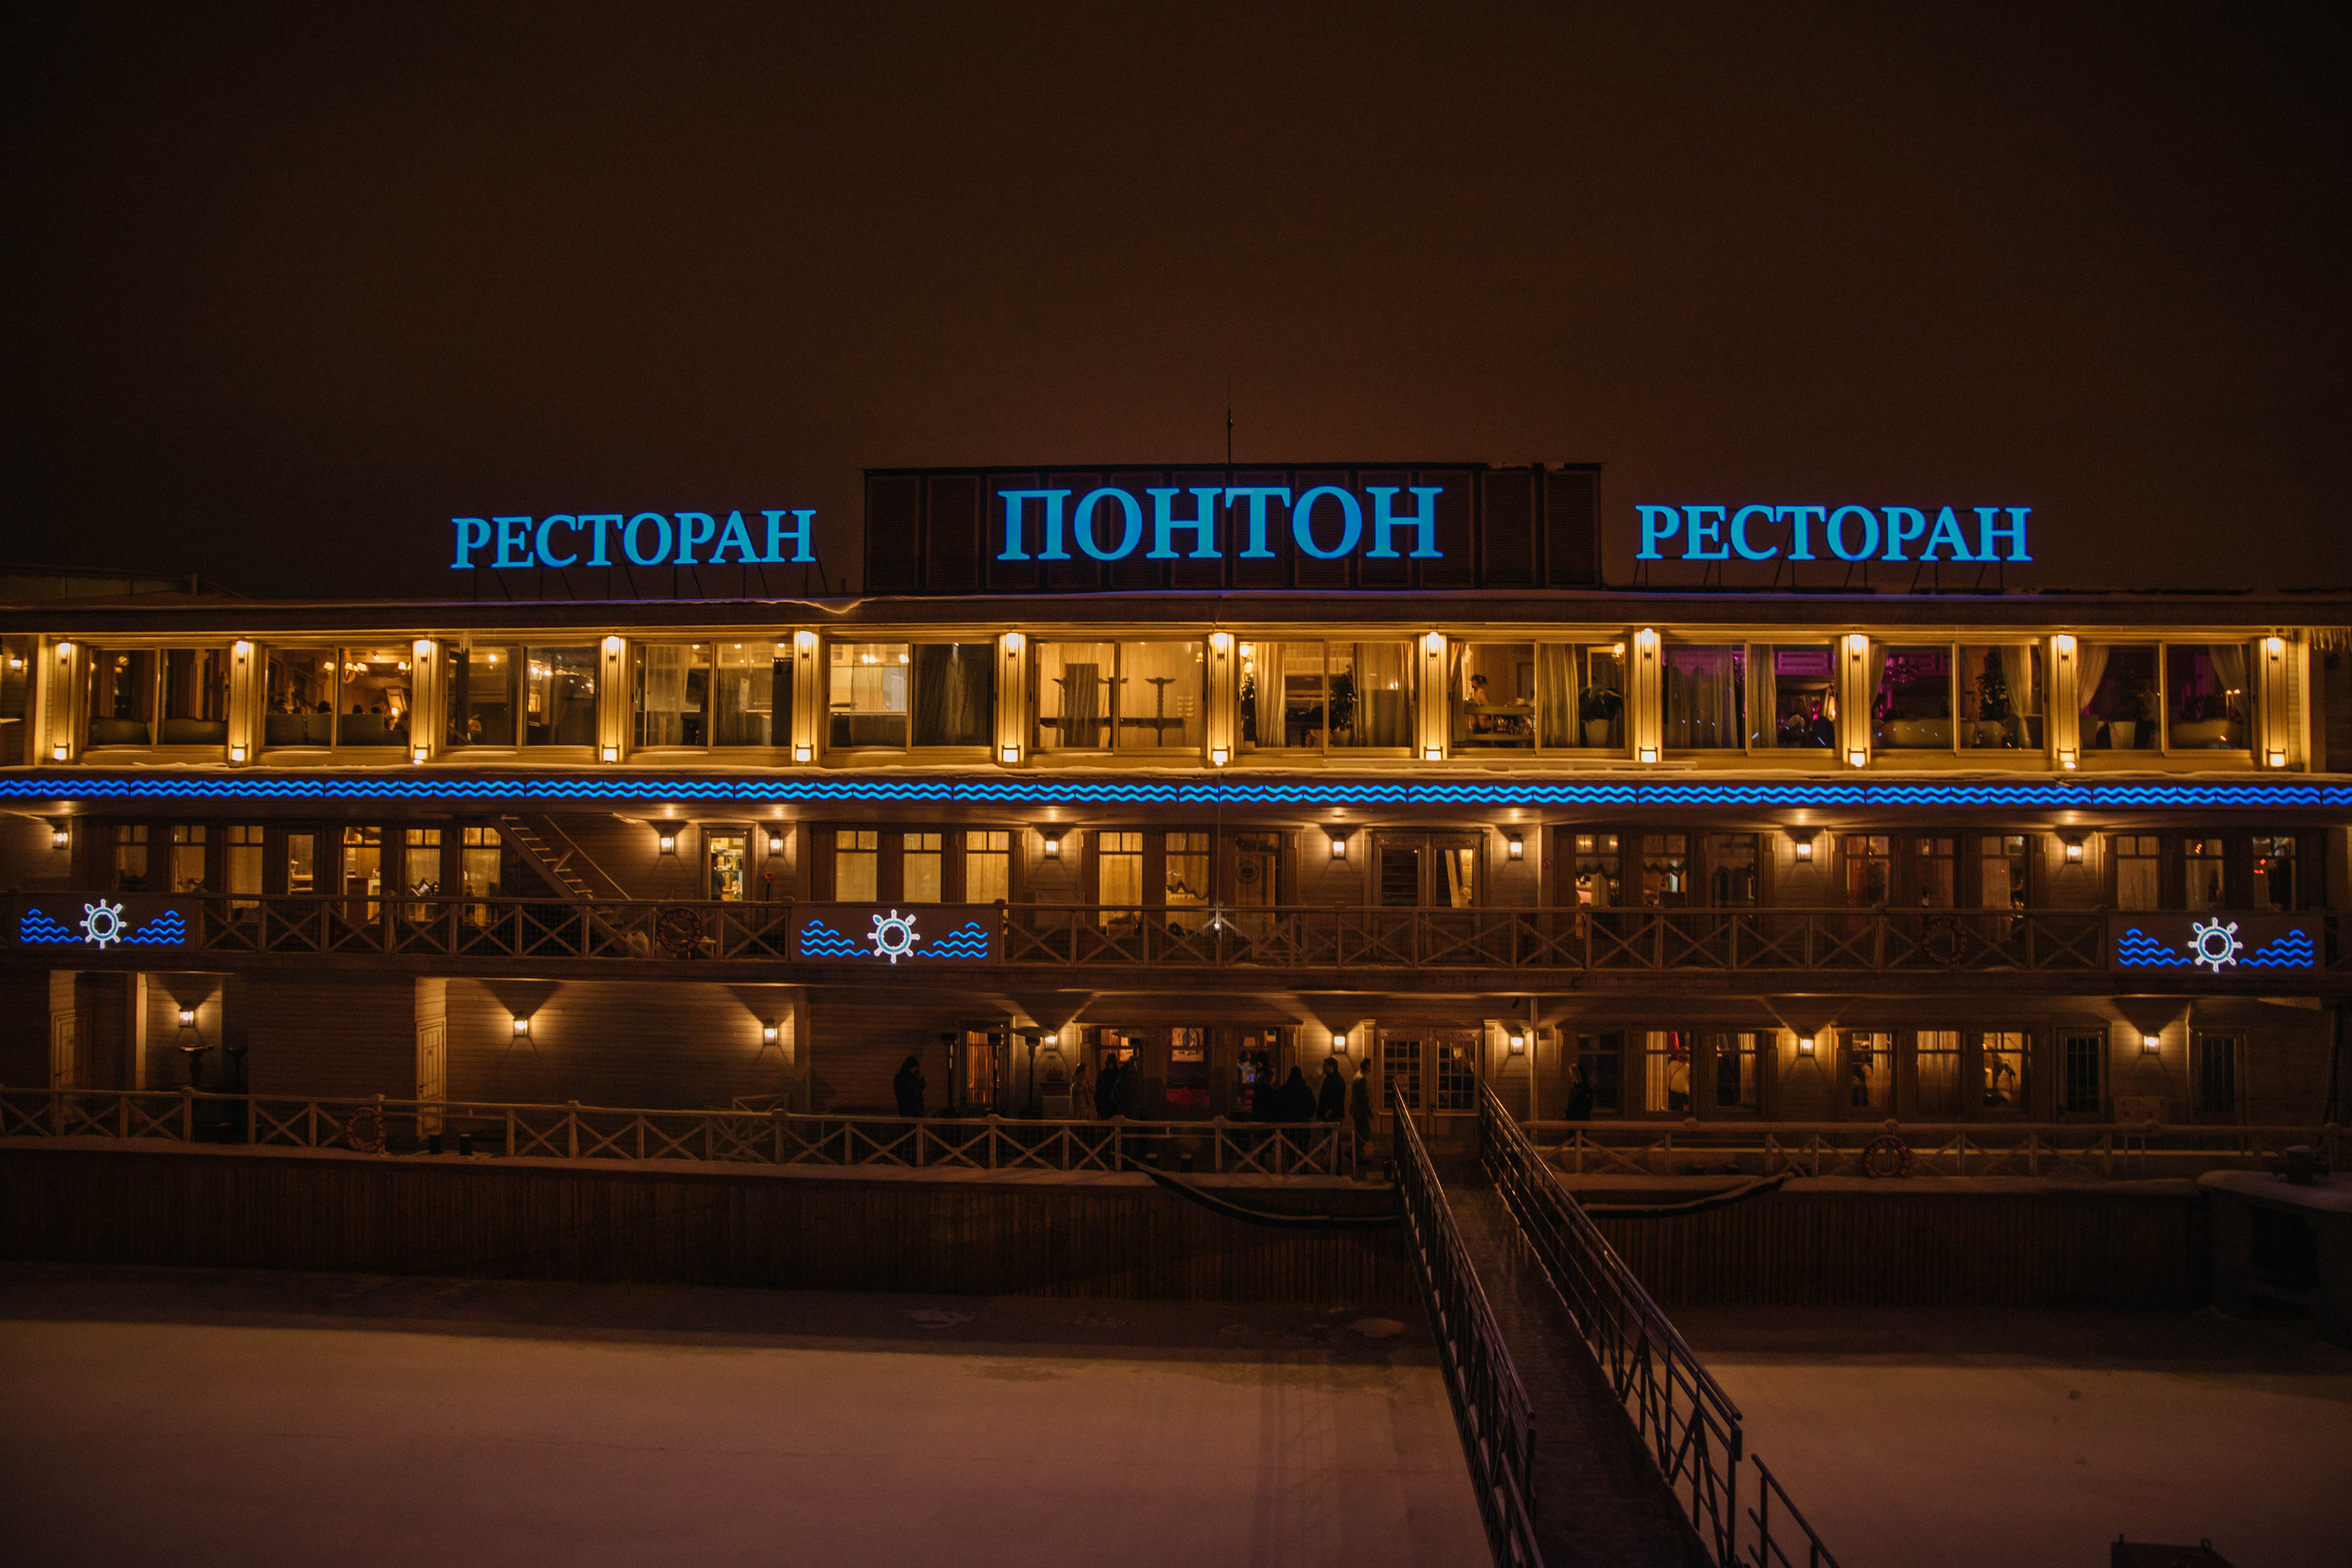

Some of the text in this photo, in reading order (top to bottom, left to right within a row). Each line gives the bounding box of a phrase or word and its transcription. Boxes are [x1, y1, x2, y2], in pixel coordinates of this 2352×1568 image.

[450, 509, 817, 570] РЕСТОРАН
[997, 485, 1443, 561] ПОНТОН
[1634, 503, 2033, 562] РЕСТОРАН
